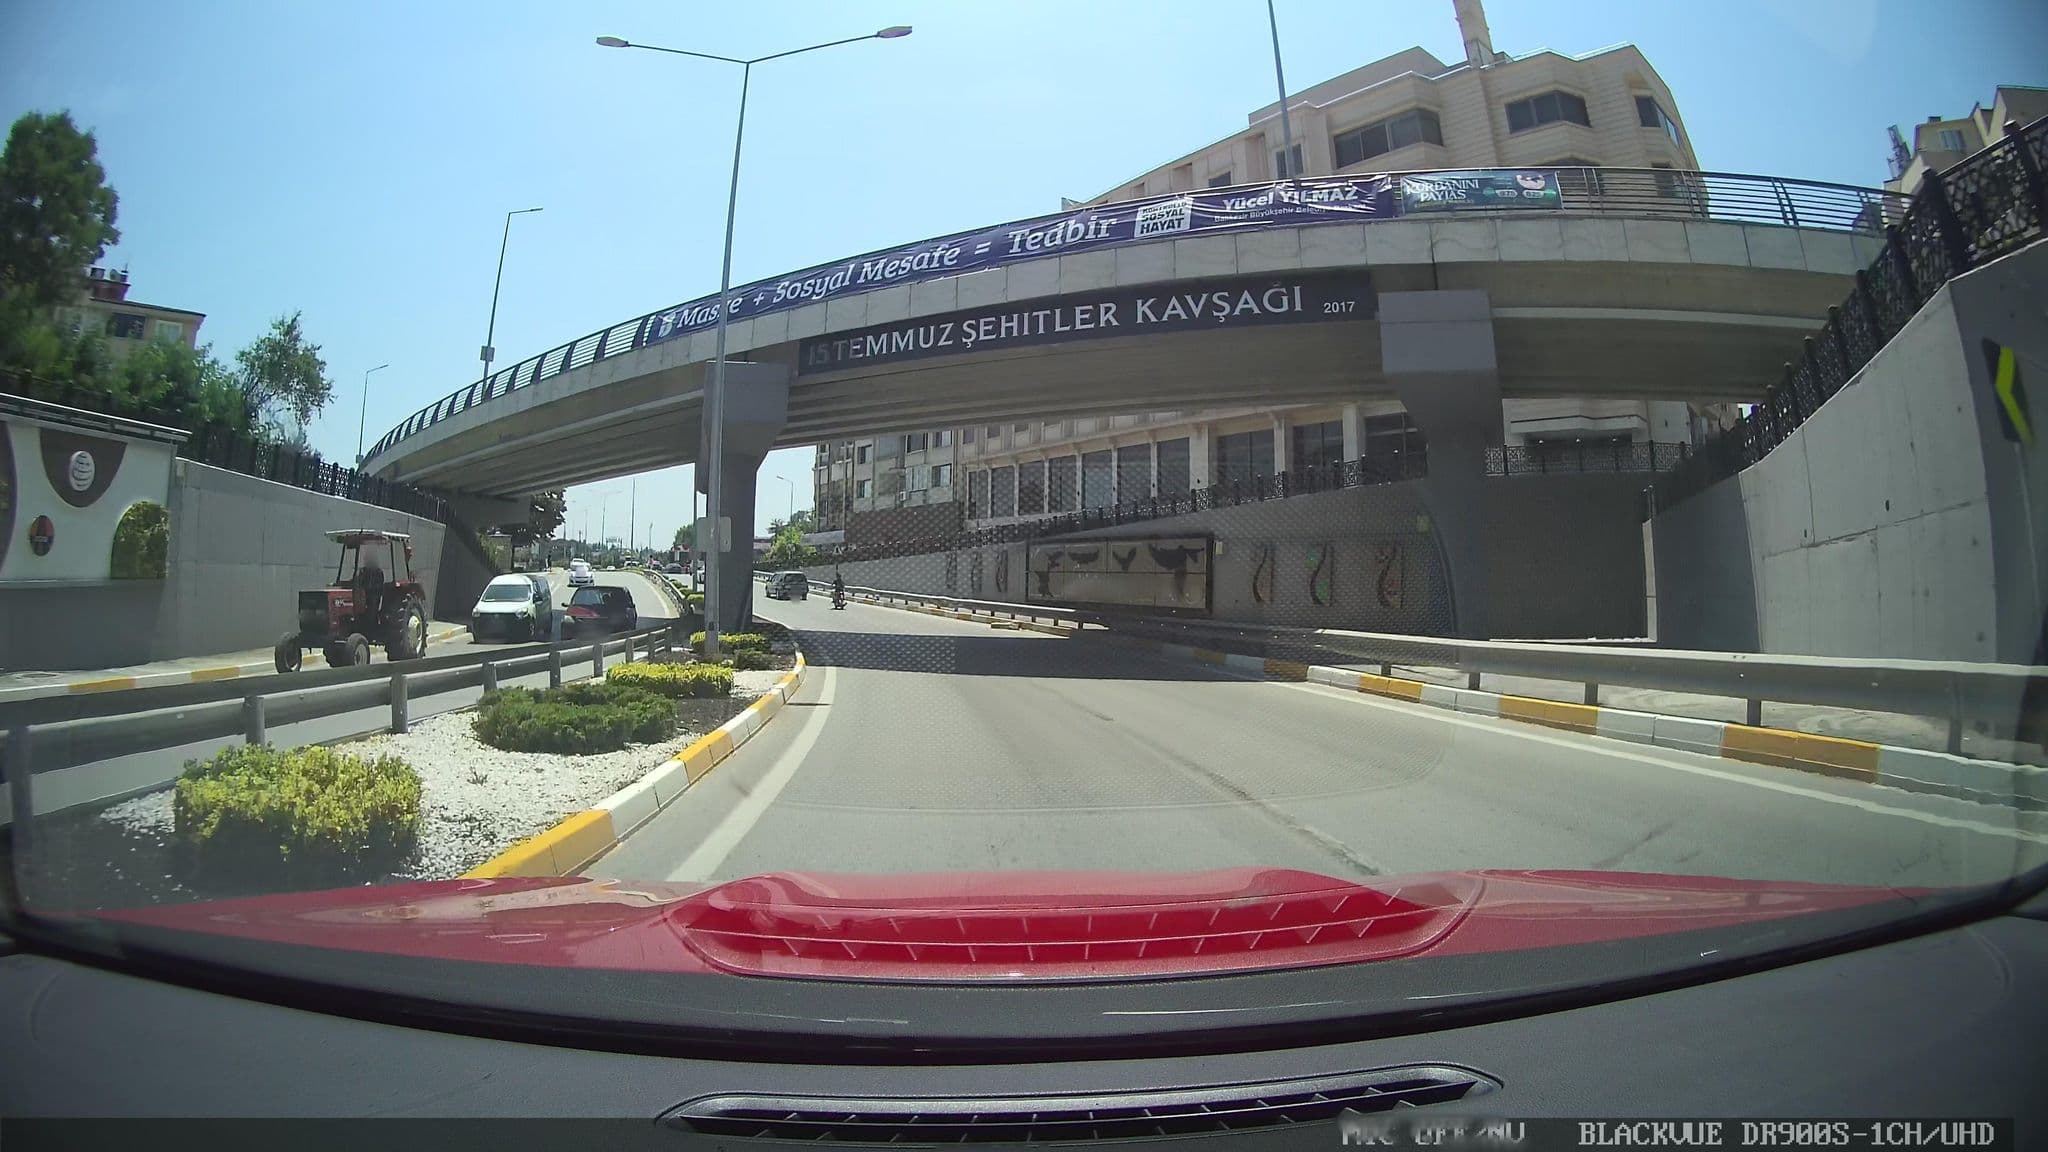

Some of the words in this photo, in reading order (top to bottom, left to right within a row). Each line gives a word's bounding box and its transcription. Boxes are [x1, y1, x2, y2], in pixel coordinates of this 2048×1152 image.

[1223, 191, 1274, 211] Yücel
[1279, 187, 1358, 205] YILMAZ
[1140, 217, 1185, 234] HAYAT
[1141, 208, 1185, 222] SOSYAL
[676, 297, 743, 328] Mase
[773, 263, 856, 300] Sosyal
[857, 247, 961, 284] Mesafe
[1008, 215, 1117, 253] Tedbir
[832, 322, 954, 361] TEMMUZ
[1135, 283, 1303, 323] KAVŞAĞI
[1323, 301, 1355, 314] 2017
